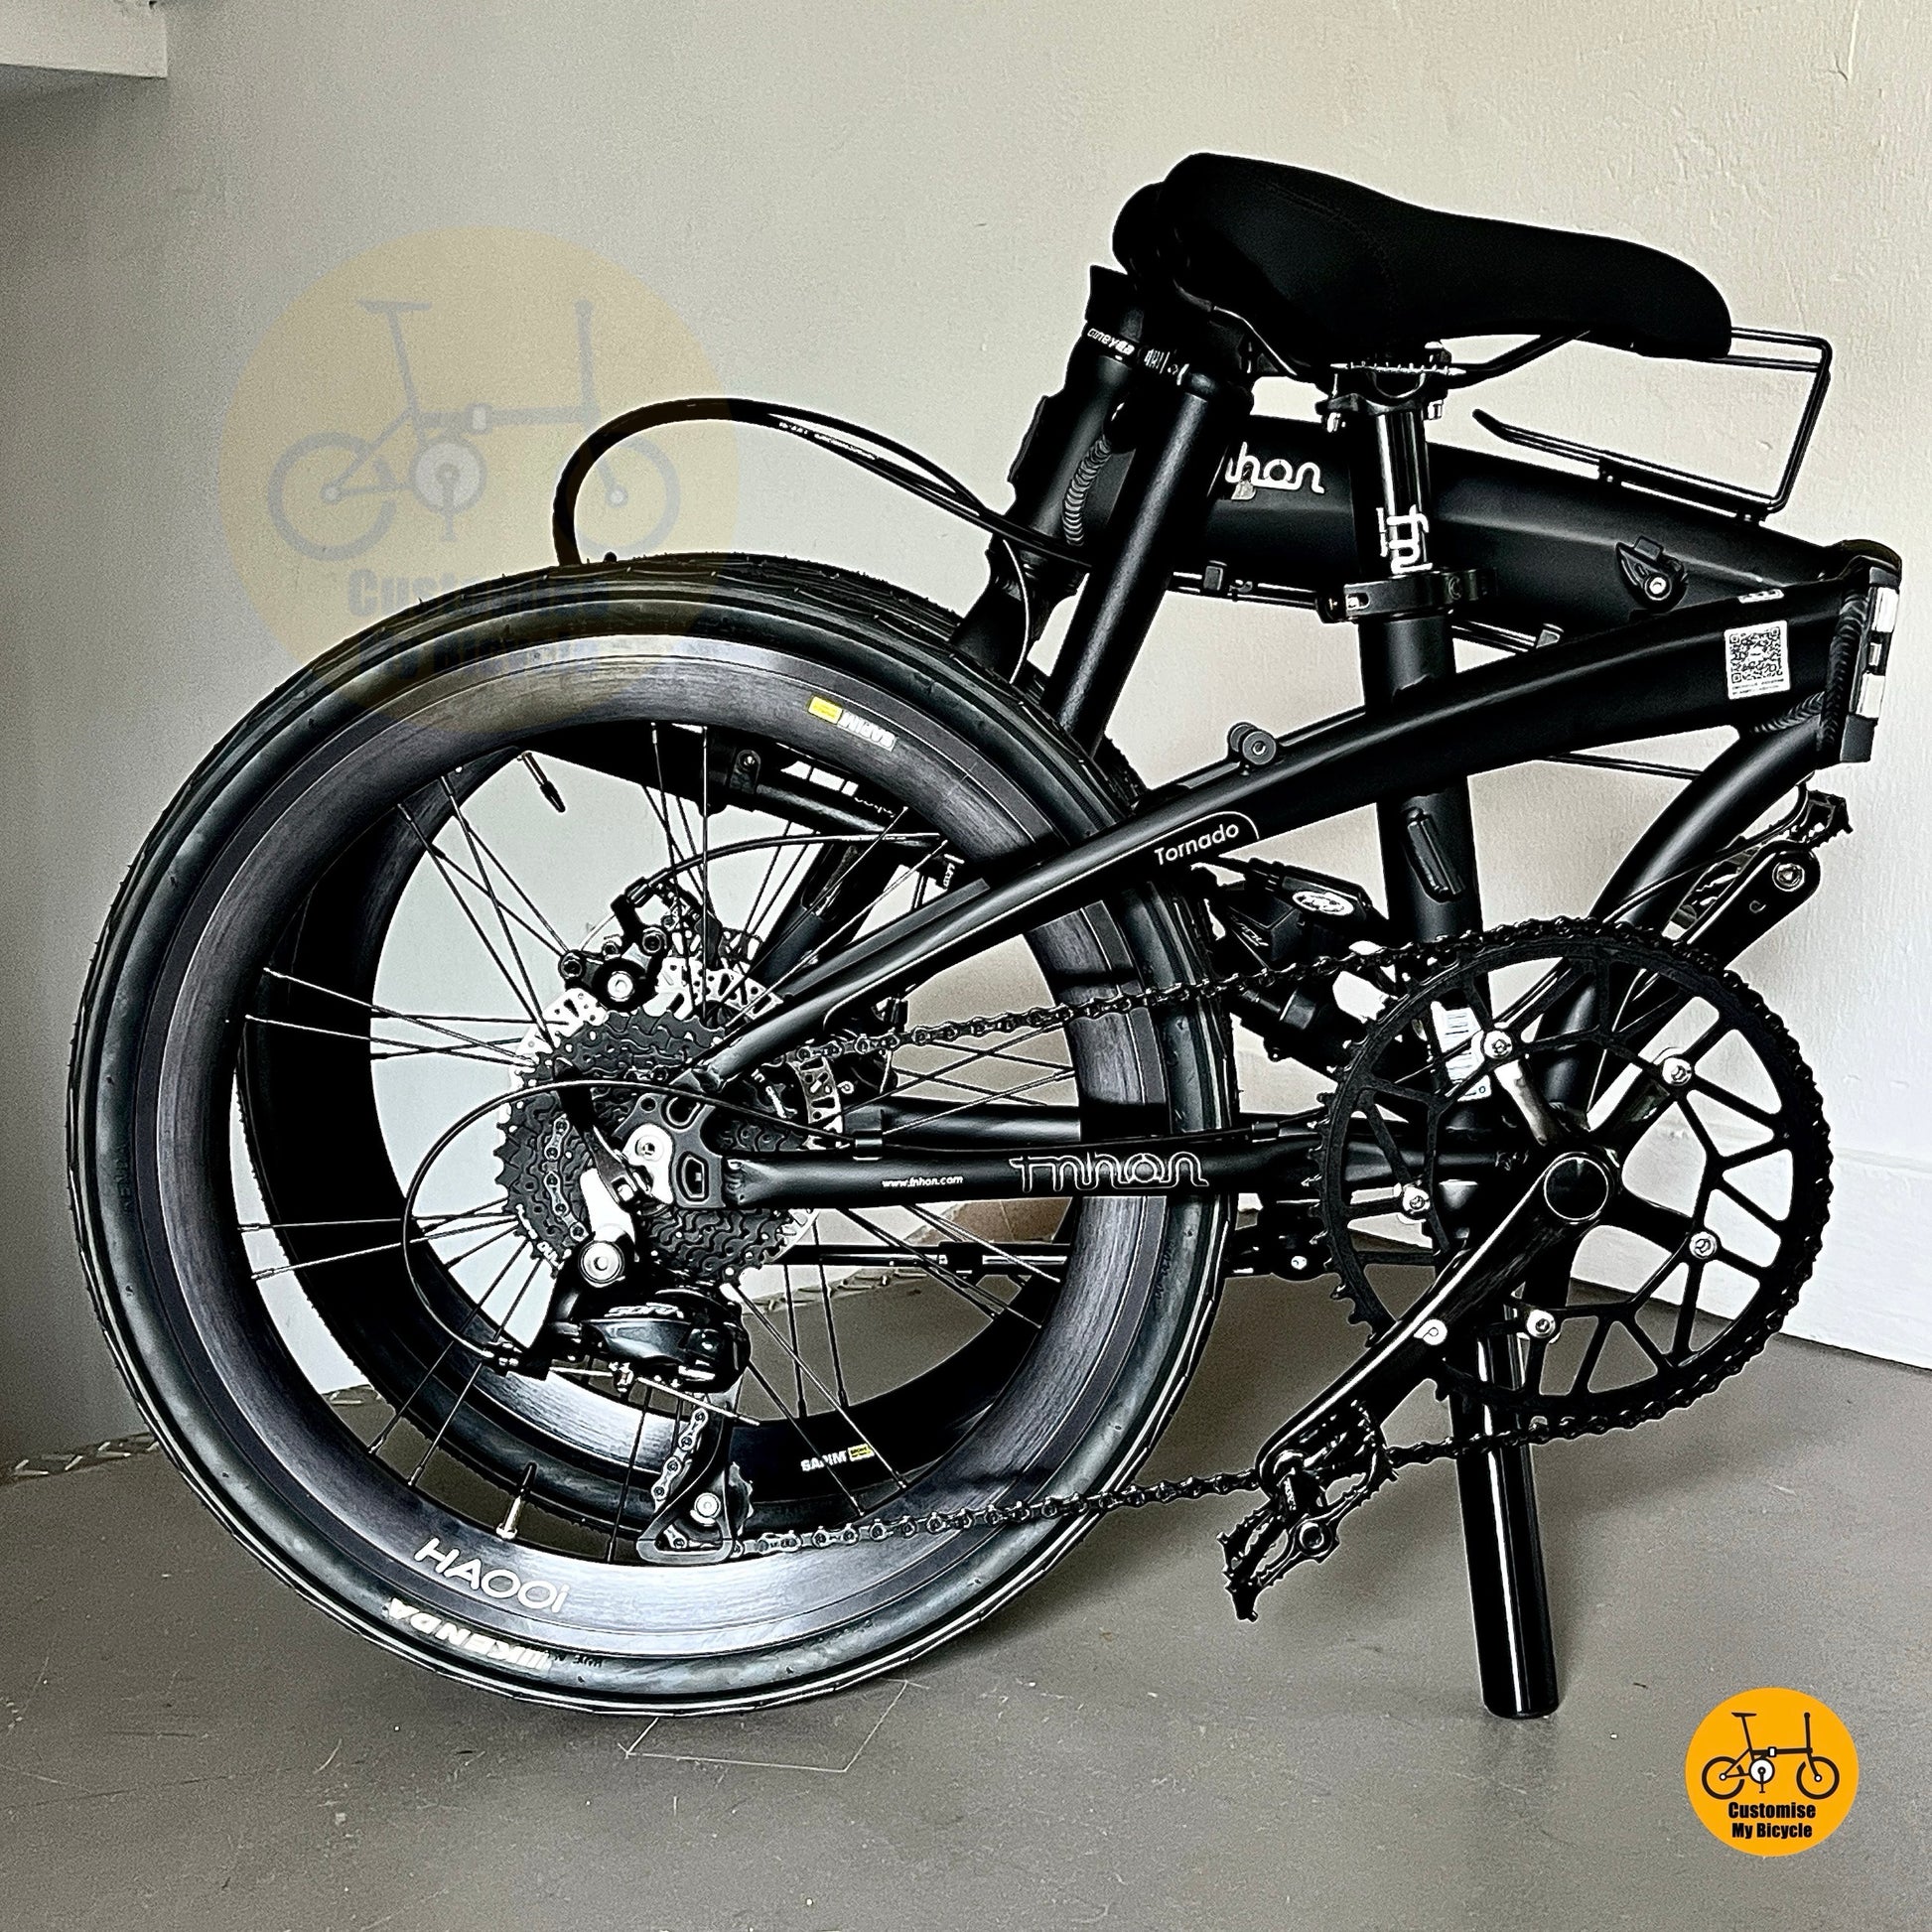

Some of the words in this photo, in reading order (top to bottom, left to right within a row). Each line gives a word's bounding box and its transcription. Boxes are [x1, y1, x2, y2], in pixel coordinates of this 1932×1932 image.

[1154, 823, 1240, 866] Tornado
[882, 1174, 963, 1188] www.fnhon.com
[381, 1596, 544, 1669] KENDA
